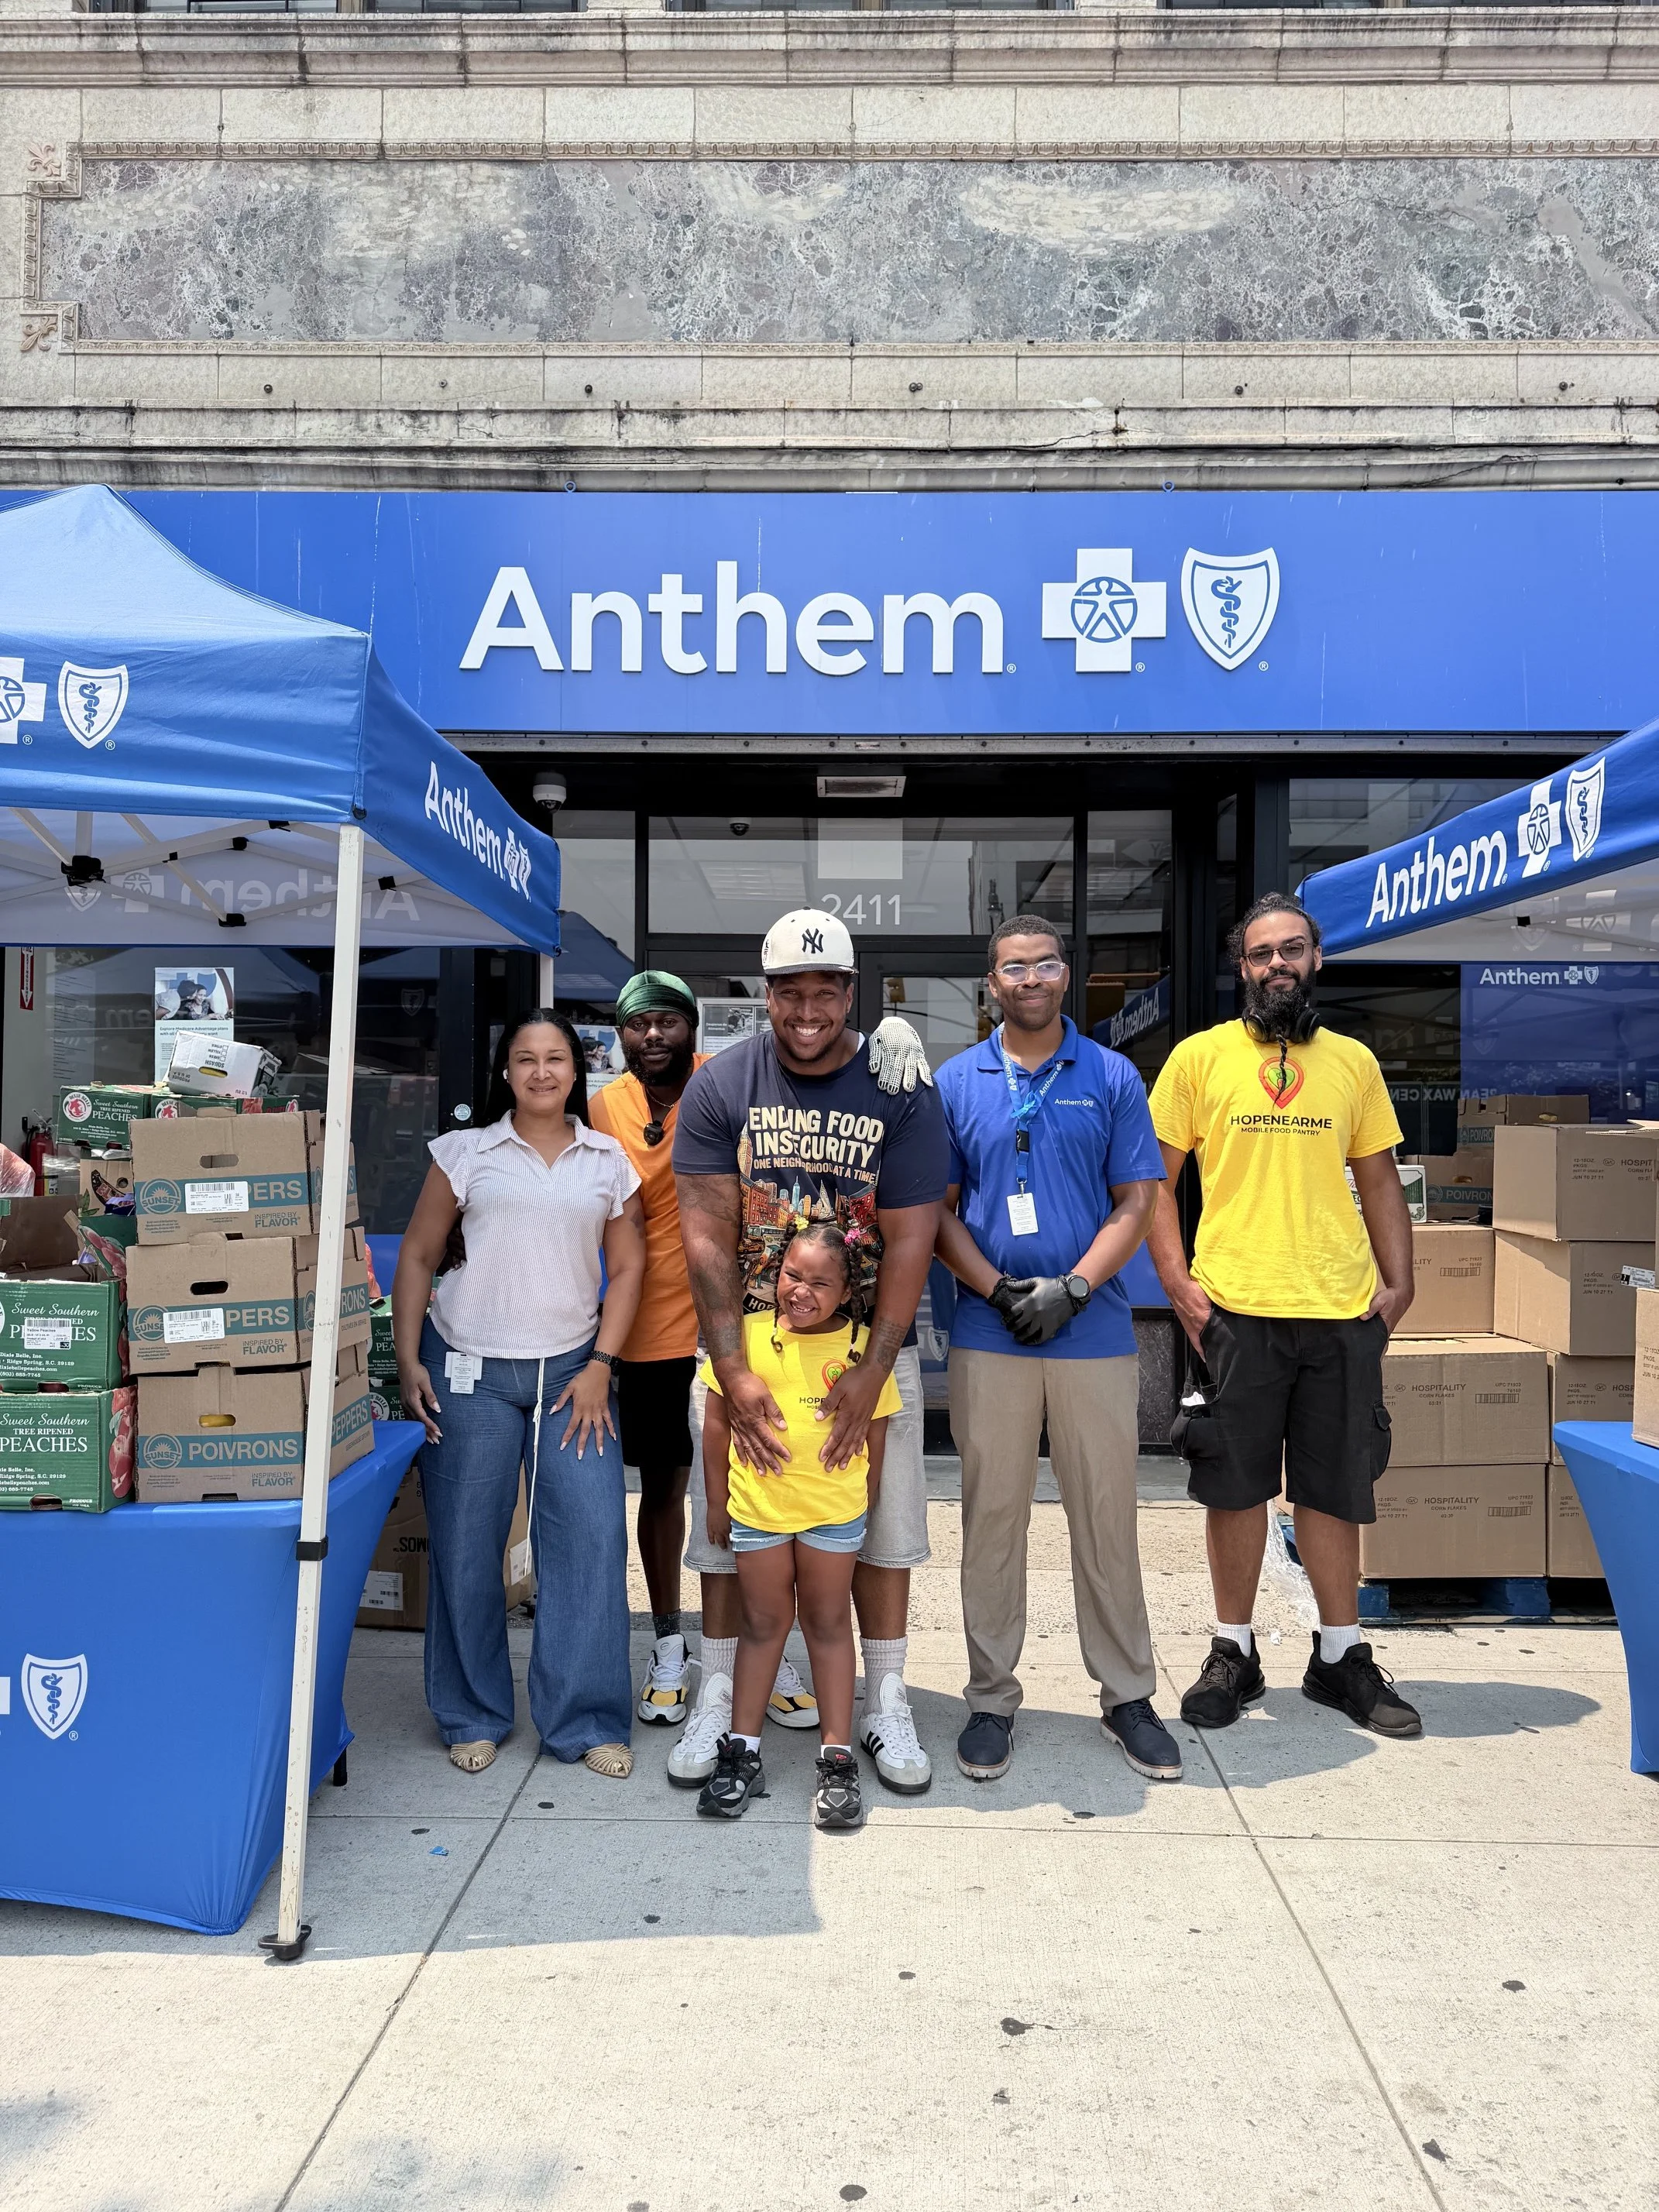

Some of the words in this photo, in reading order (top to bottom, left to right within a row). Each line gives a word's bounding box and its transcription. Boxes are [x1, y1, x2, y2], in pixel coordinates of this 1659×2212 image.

[459, 560, 1005, 675] Anthem
[424, 761, 504, 880] Anthem
[1365, 830, 1507, 929] Anthem
[821, 893, 901, 926] 2411
[1479, 967, 1560, 985] Anthem
[204, 1060, 225, 1068] SQUASH
[1039, 1070, 1059, 1097] Anthem
[112, 1099, 139, 1110] Southern
[92, 1110, 138, 1121] PEACHES
[1231, 1115, 1333, 1129] HOPENEARME
[748, 1105, 822, 1134] ENDING
[826, 1110, 884, 1143] FOOD
[755, 1130, 875, 1169] INSECURITY
[754, 1158, 771, 1170] ONE
[833, 1165, 843, 1178] AT
[844, 1167, 851, 1179] A
[854, 1169, 876, 1183] TIME
[248, 1180, 303, 1201] ERS
[142, 1197, 180, 1207] SUNSET
[254, 1212, 286, 1221] INSPIRED
[255, 1218, 299, 1228] FLAVOR
[11, 1302, 46, 1314] Sweet
[49, 1304, 100, 1317] Southern
[135, 1323, 164, 1335] SUNSE
[242, 1344, 285, 1355] FLAVOR
[1411, 1383, 1467, 1392] HOSPITALITY
[0, 1413, 35, 1426] Sweet
[38, 1413, 90, 1426] Southern
[0, 1437, 88, 1452] PEACHES
[189, 1438, 298, 1461] POIVRONS
[145, 1450, 181, 1462] SUNSET
[252, 1477, 294, 1487] FLAVOR
[399, 1537, 430, 1553] MOS
